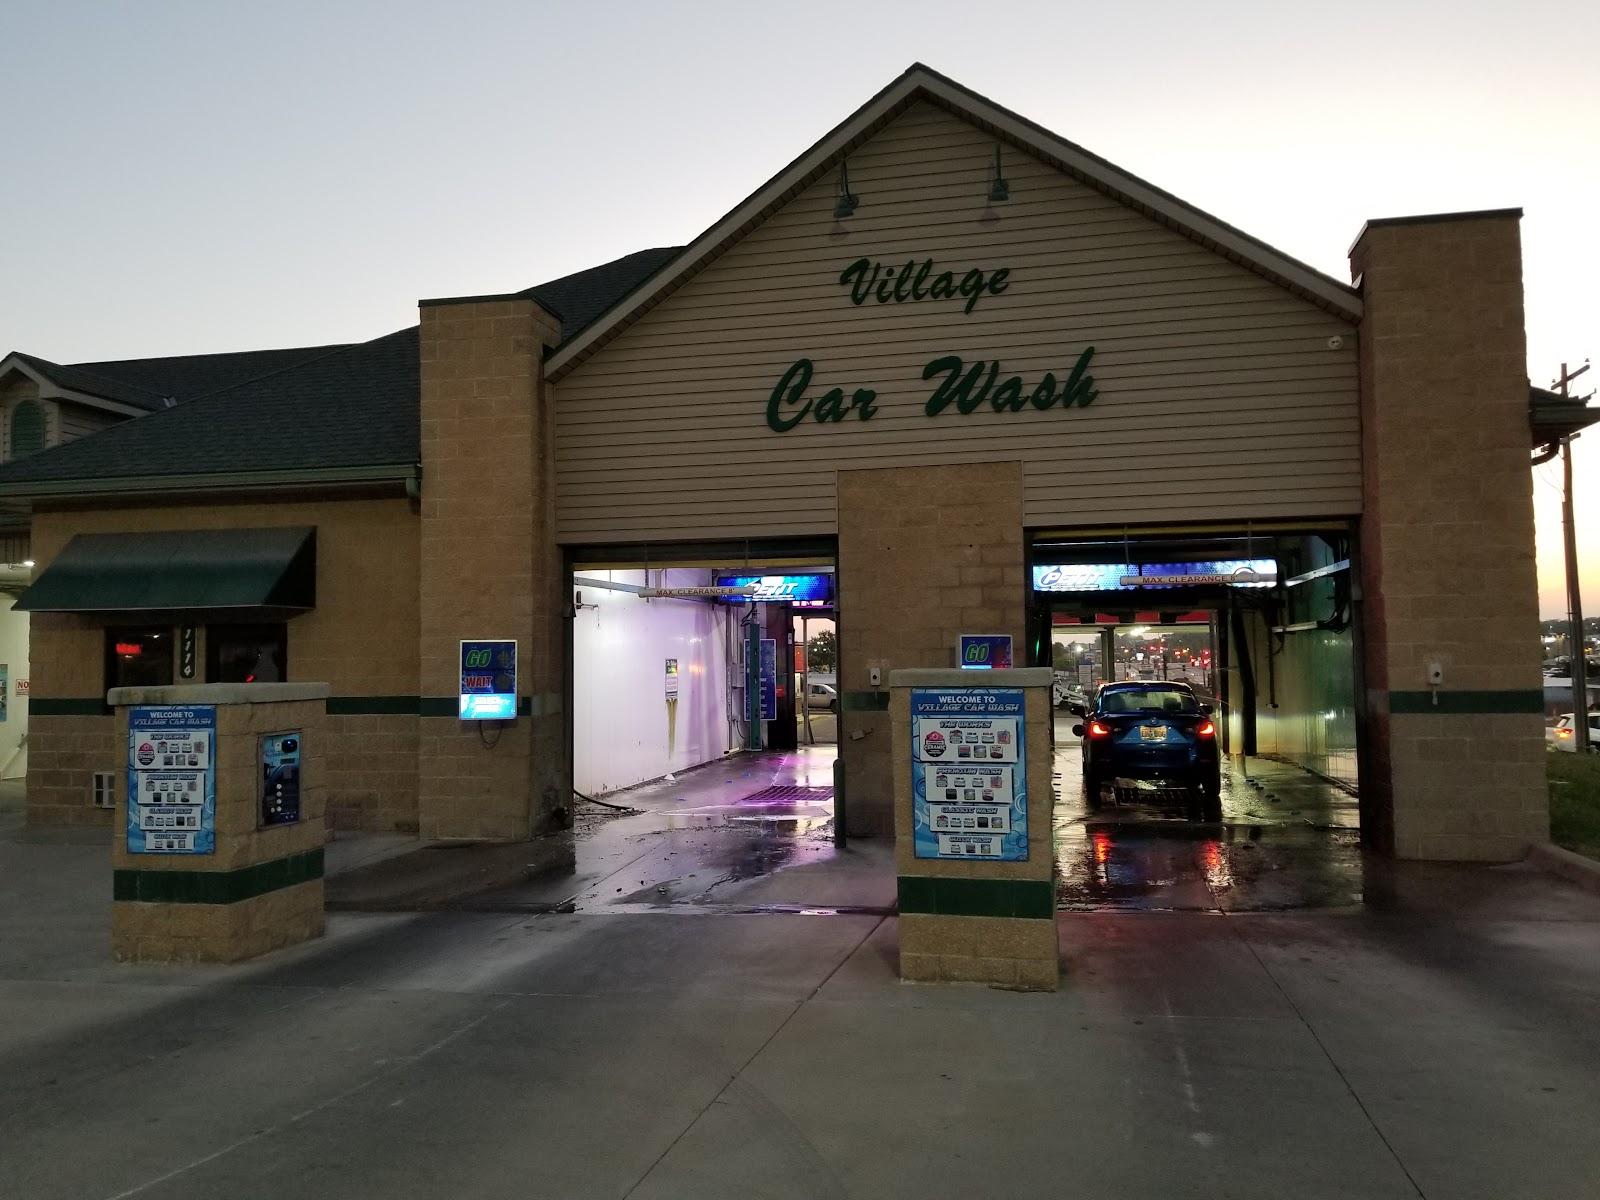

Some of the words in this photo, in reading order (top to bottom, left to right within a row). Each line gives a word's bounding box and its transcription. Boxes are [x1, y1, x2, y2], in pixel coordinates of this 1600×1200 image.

[839, 257, 1010, 315] Village
[766, 358, 879, 432] Car
[921, 345, 1100, 418] Wash
[1168, 575, 1228, 584] CLEARANCE
[465, 649, 492, 668] GO
[965, 643, 989, 663] GO
[17, 681, 29, 689] NO
[465, 676, 493, 688] WAIT
[918, 704, 962, 712] VILLAGE
[964, 704, 986, 712] CAR
[988, 704, 1020, 712] WASH
